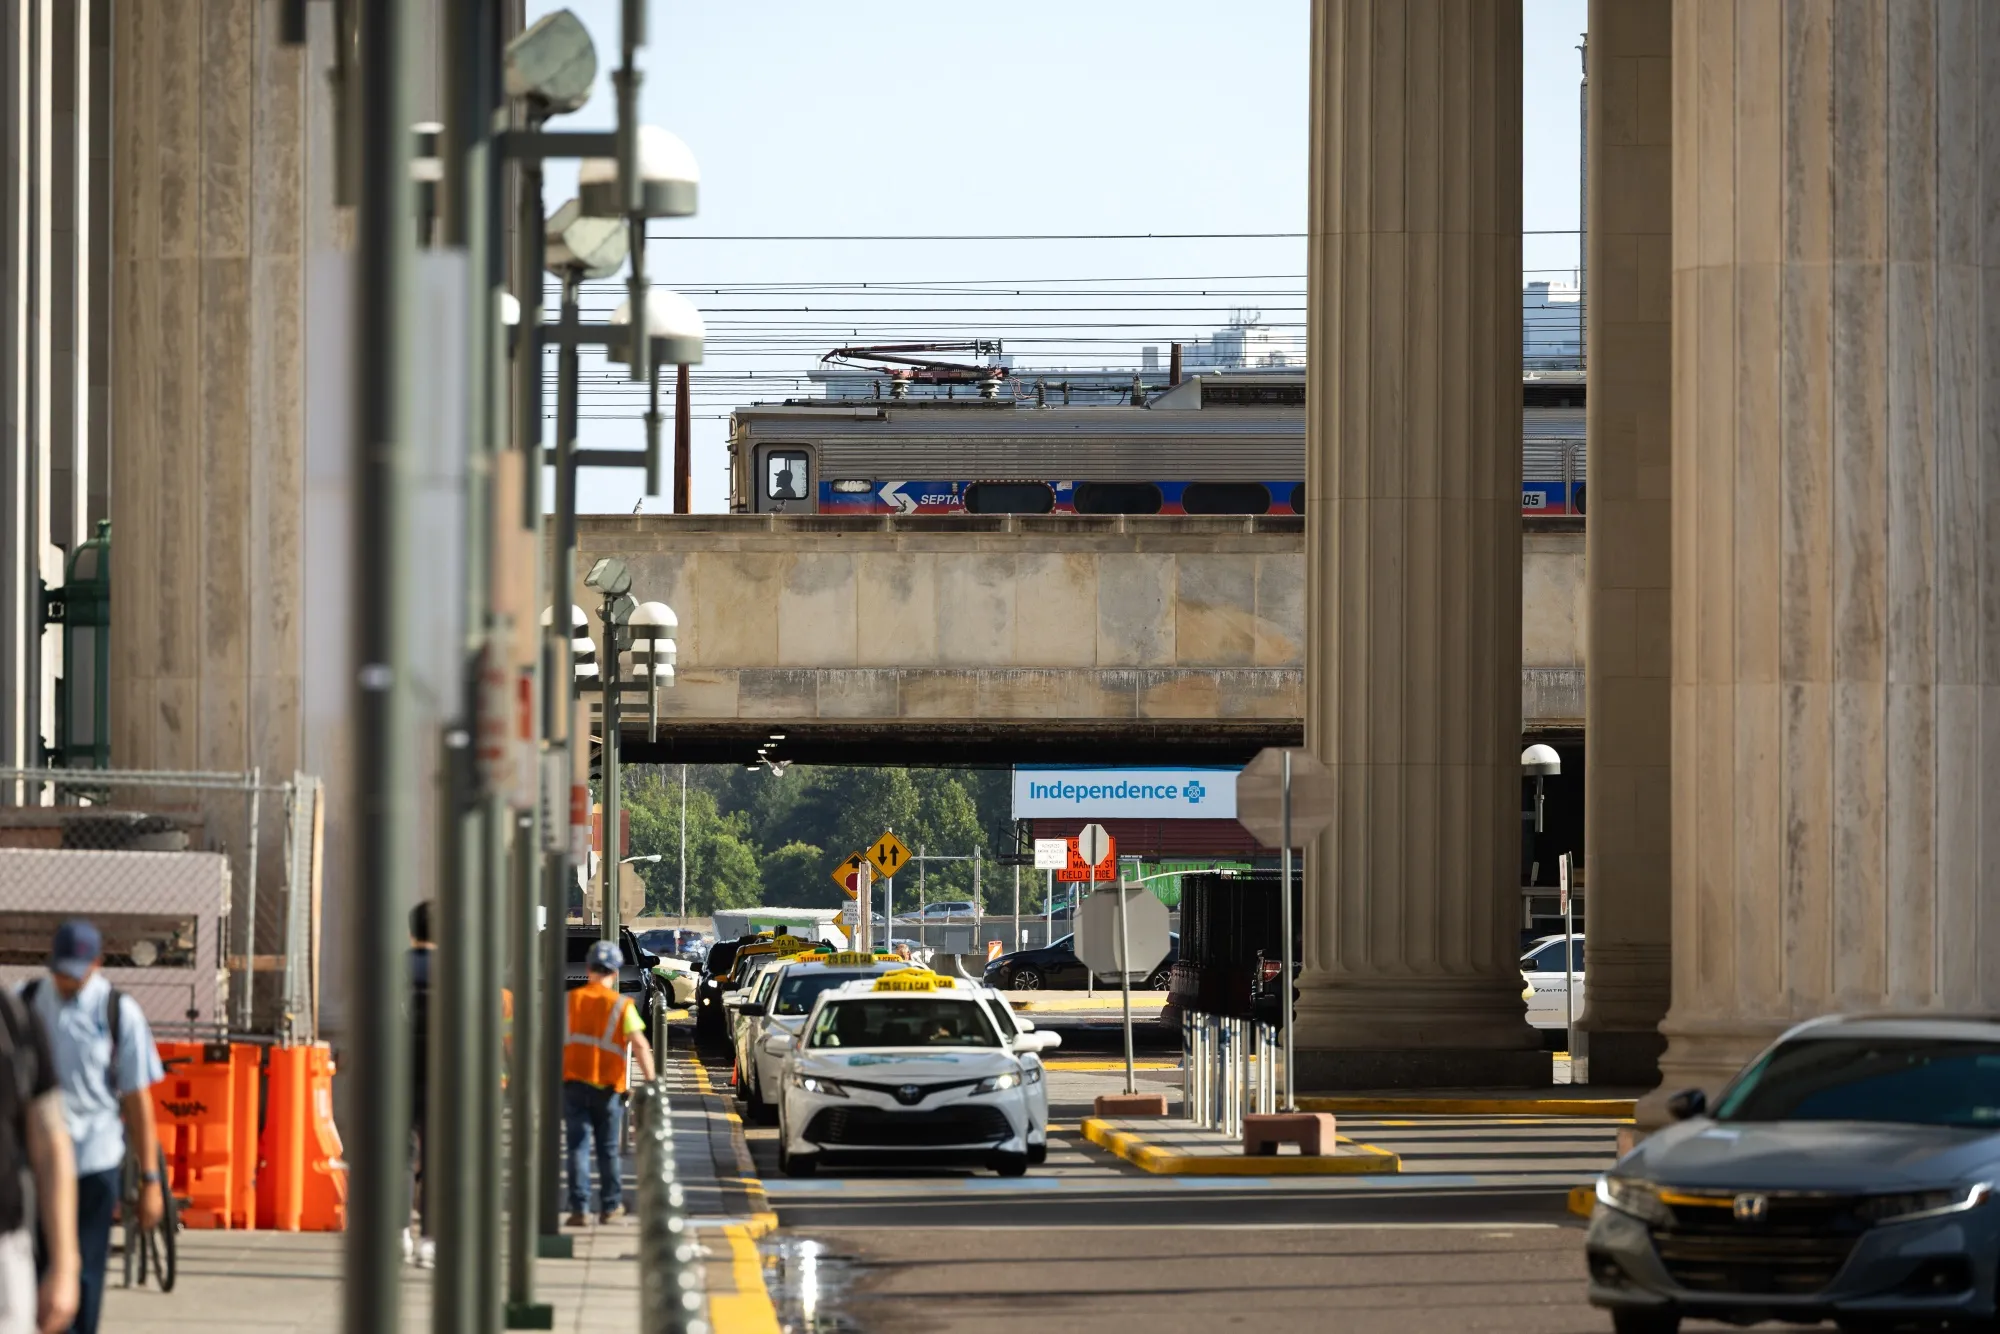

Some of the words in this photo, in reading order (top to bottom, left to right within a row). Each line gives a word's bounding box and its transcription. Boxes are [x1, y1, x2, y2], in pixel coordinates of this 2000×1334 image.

[920, 494, 960, 505] SEPTA
[1030, 780, 1177, 804] Independence
[1104, 860, 1114, 868] ST
[1062, 870, 1083, 880] FIELD
[1085, 870, 1111, 879] OFICE
[776, 939, 795, 947] TAXI
[914, 981, 930, 991] CAB
